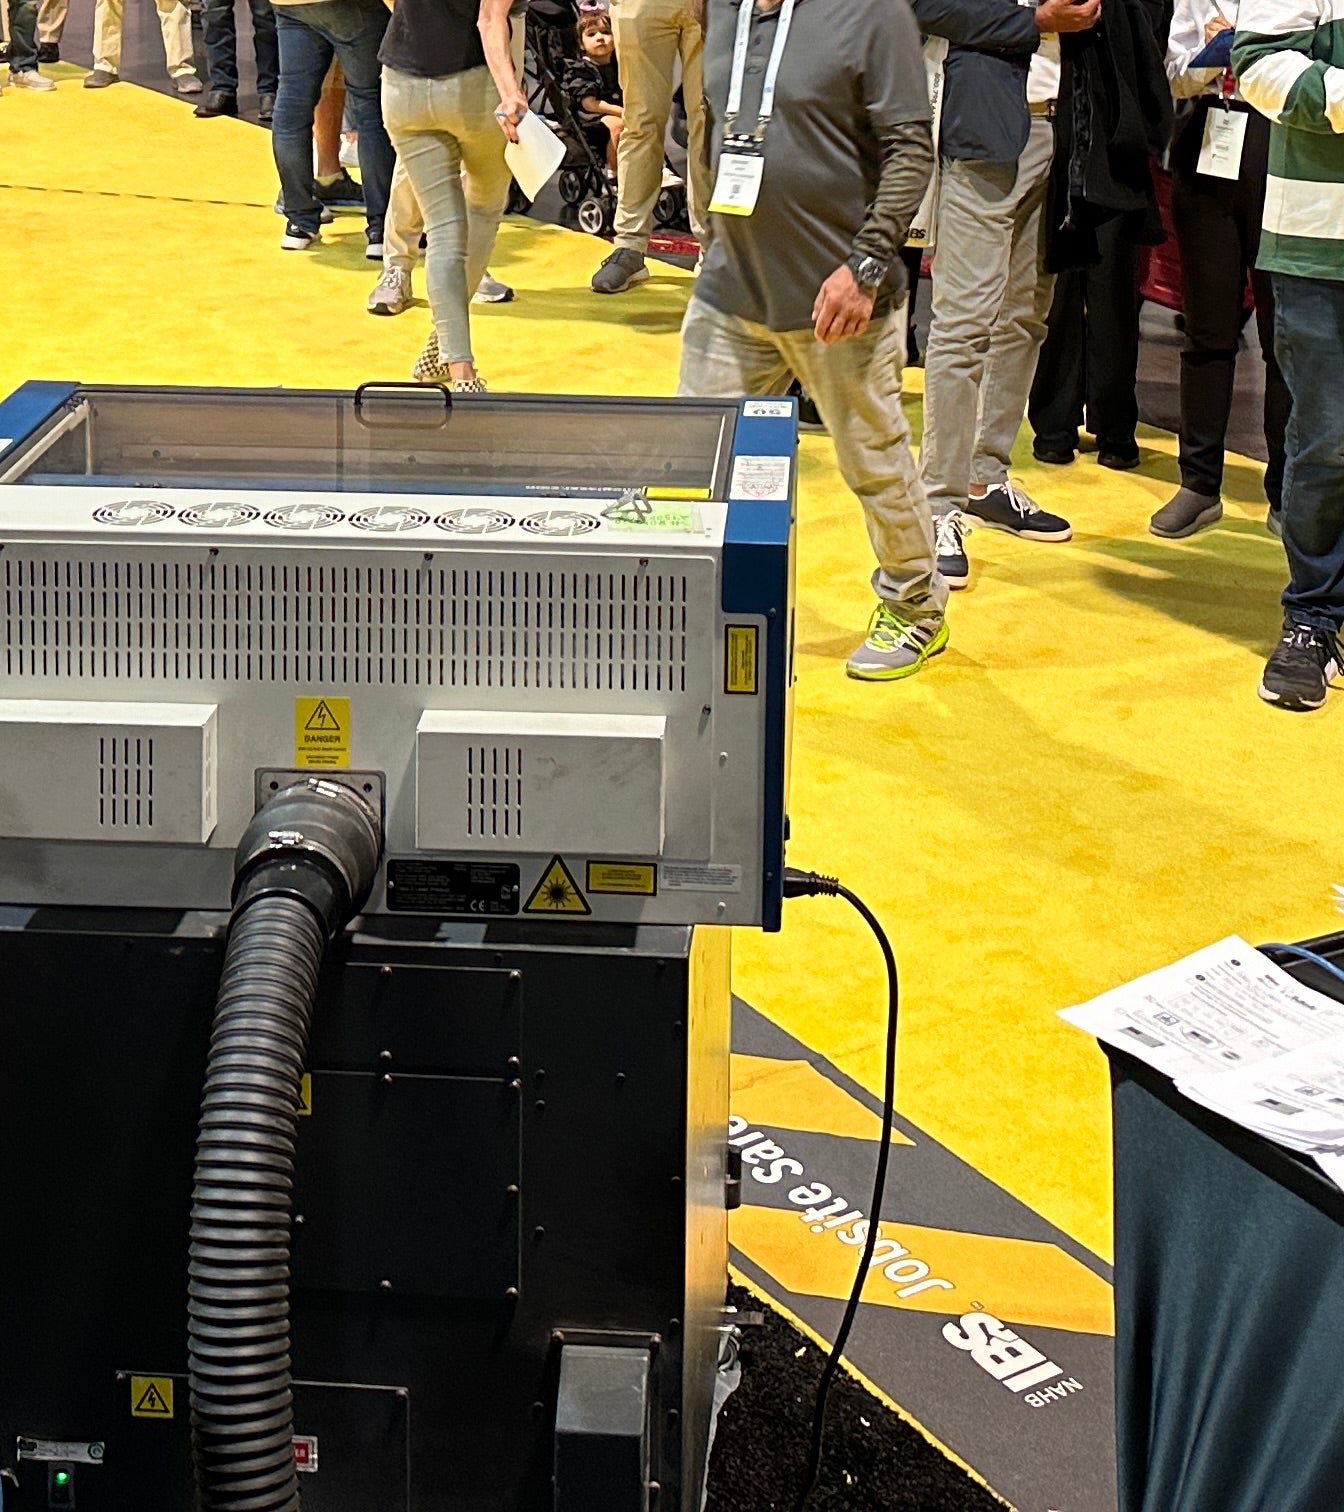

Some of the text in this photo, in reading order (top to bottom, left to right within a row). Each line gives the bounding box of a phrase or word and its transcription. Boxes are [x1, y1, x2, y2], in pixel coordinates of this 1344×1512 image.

[304, 734, 341, 743] DANGER
[787, 1181, 956, 1299] Jobsite
[942, 1312, 1064, 1393] IBS
[1024, 1377, 1084, 1408] NAHB
